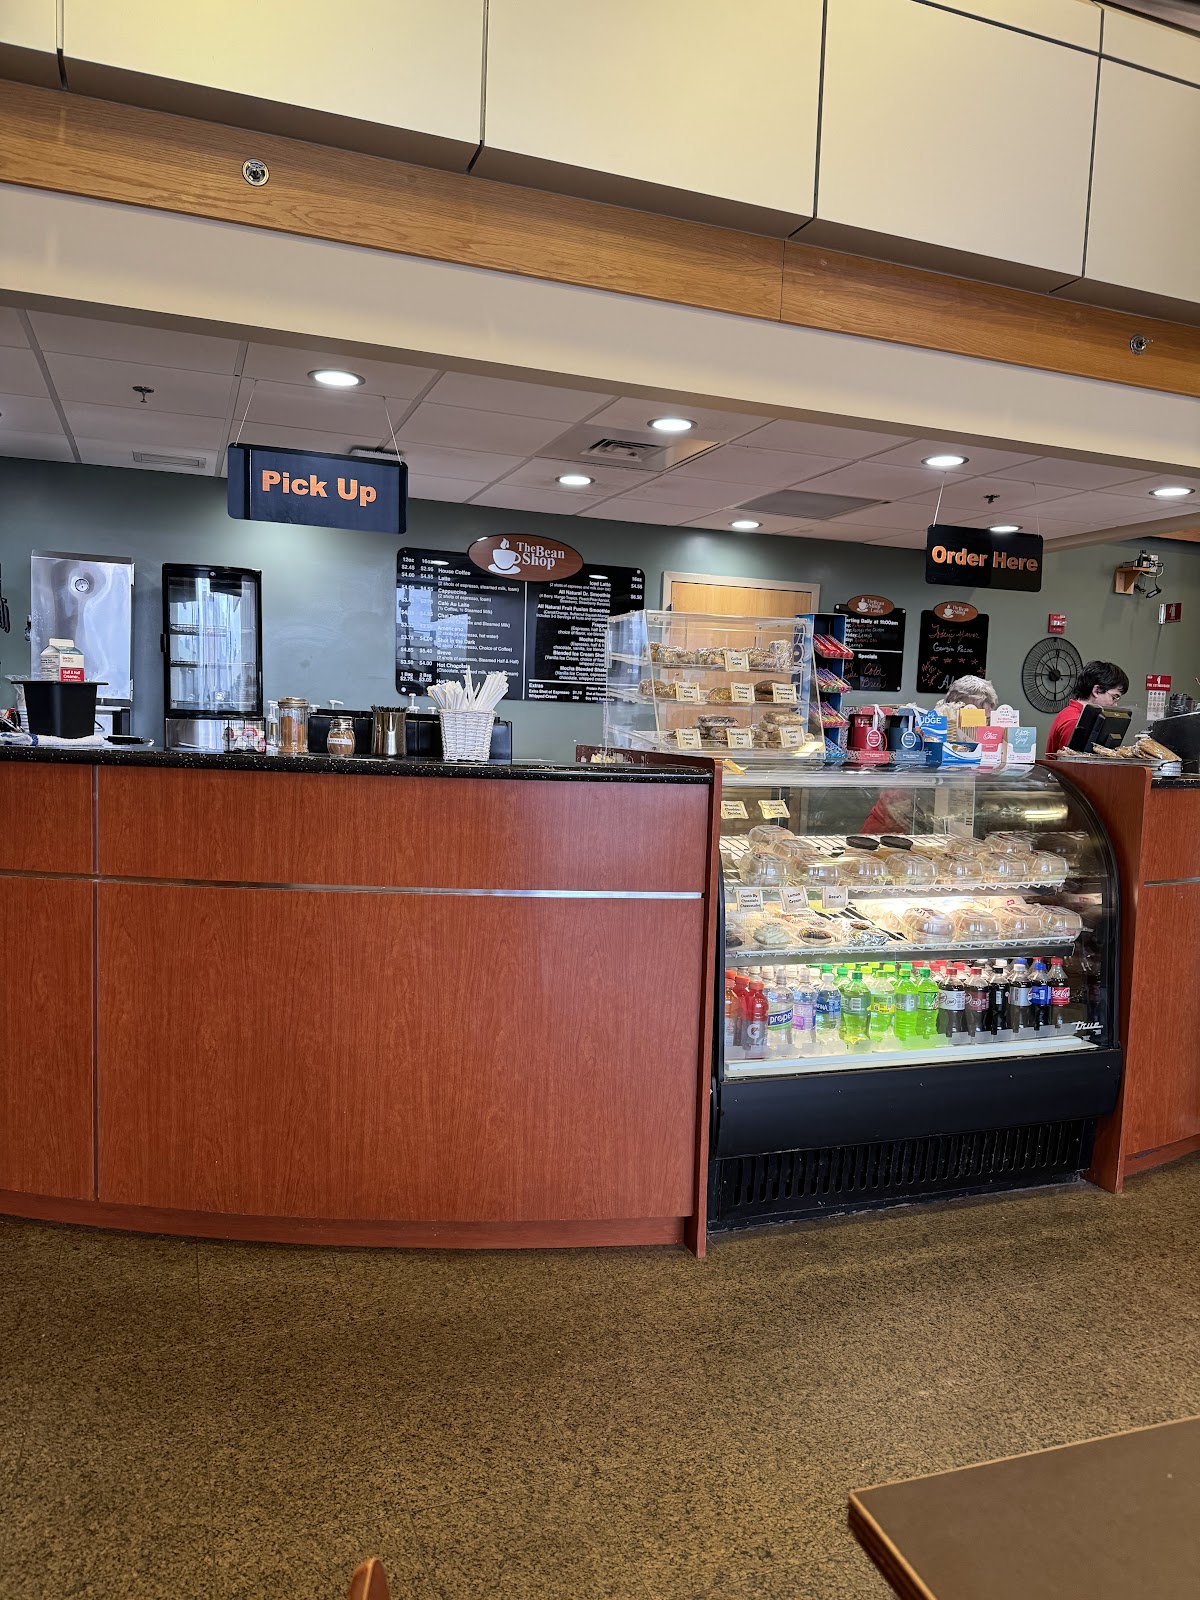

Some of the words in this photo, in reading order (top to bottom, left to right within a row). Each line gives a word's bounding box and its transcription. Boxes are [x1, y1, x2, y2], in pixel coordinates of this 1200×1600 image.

[262, 470, 328, 498] Pick
[338, 478, 377, 507] Up
[522, 552, 556, 570] Shop
[932, 546, 988, 566] Order
[992, 551, 1038, 572] Here
[438, 588, 467, 596] Cappuccino
